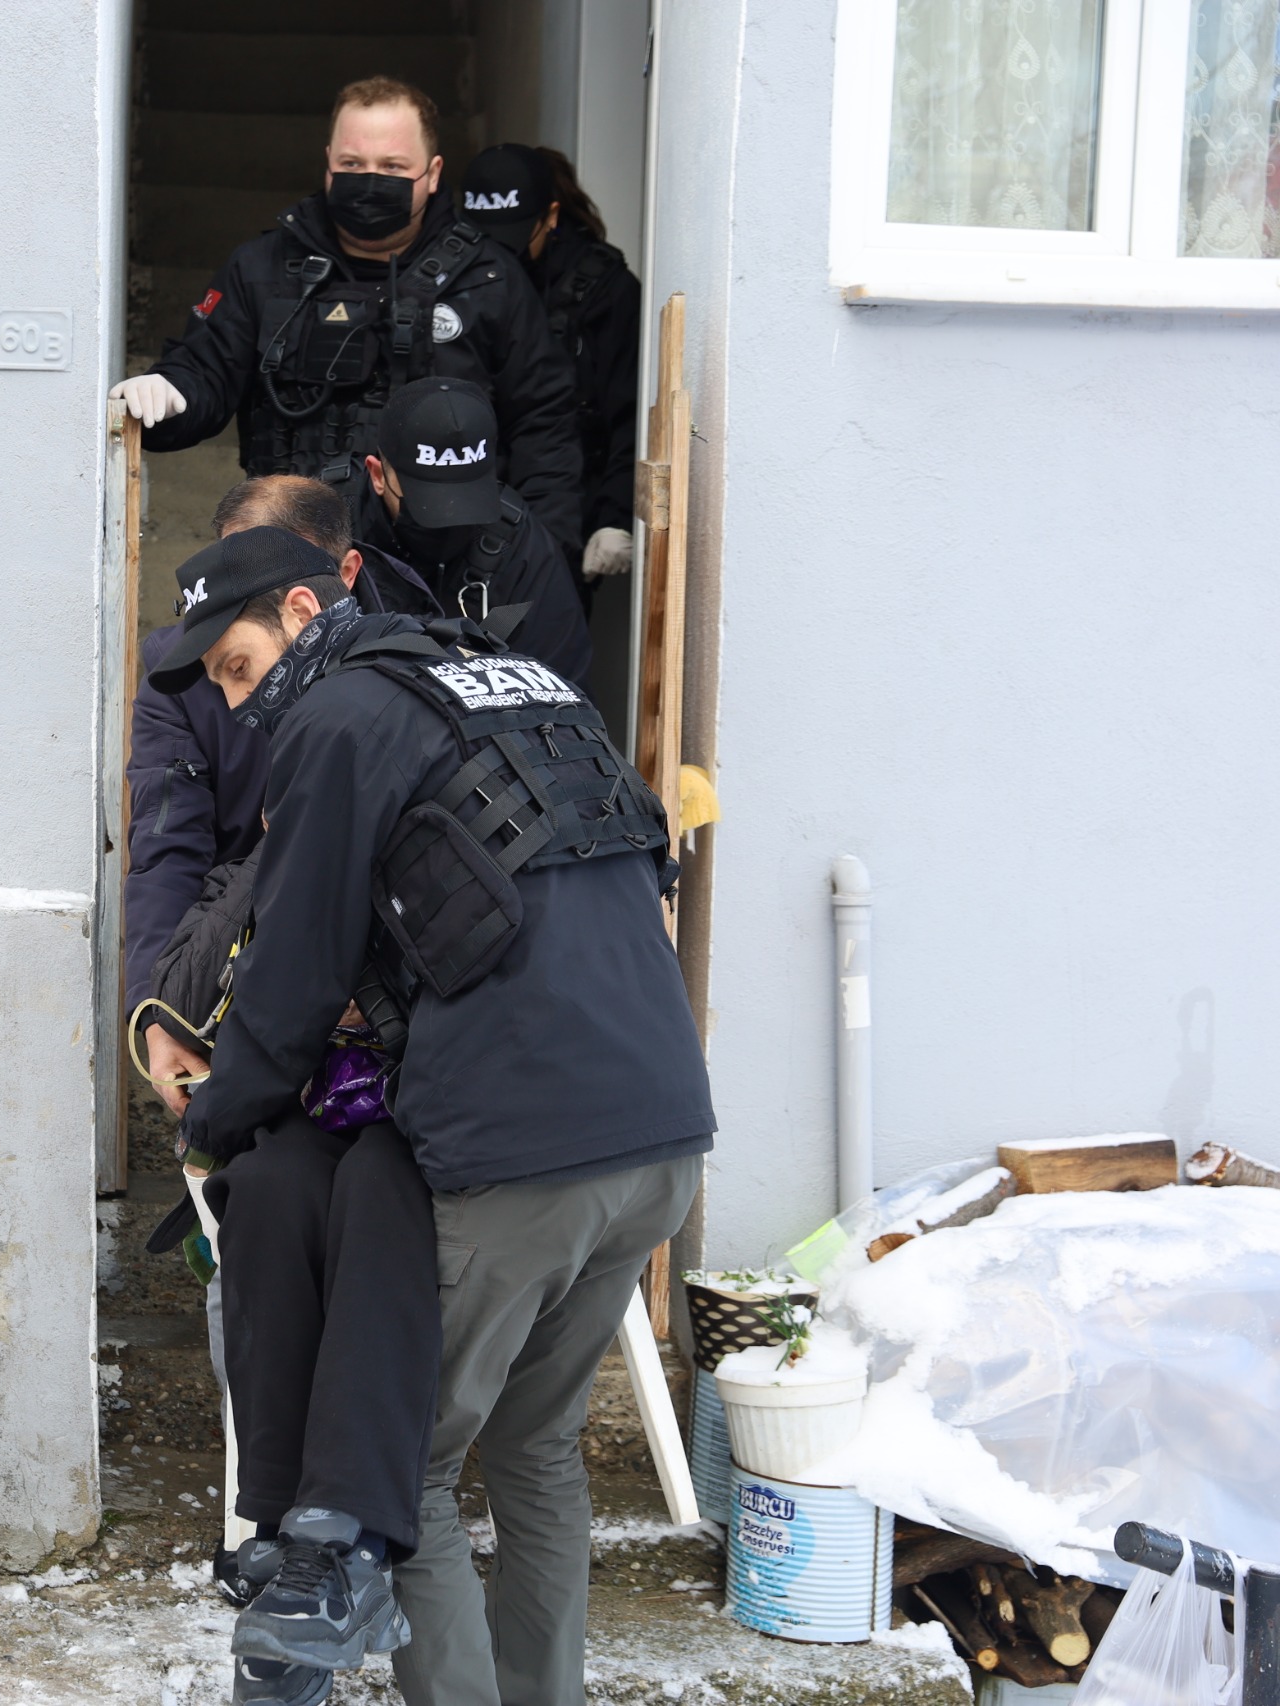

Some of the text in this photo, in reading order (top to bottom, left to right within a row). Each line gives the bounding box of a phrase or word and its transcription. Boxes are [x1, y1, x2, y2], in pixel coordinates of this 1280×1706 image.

[464, 189, 520, 210] BAM
[415, 438, 487, 467] BAM
[463, 657, 547, 673] MÜDAHALE
[437, 668, 571, 698] BAM
[462, 689, 582, 710] EMERGENCY RESPONSE
[740, 1487, 792, 1519] BURCU
